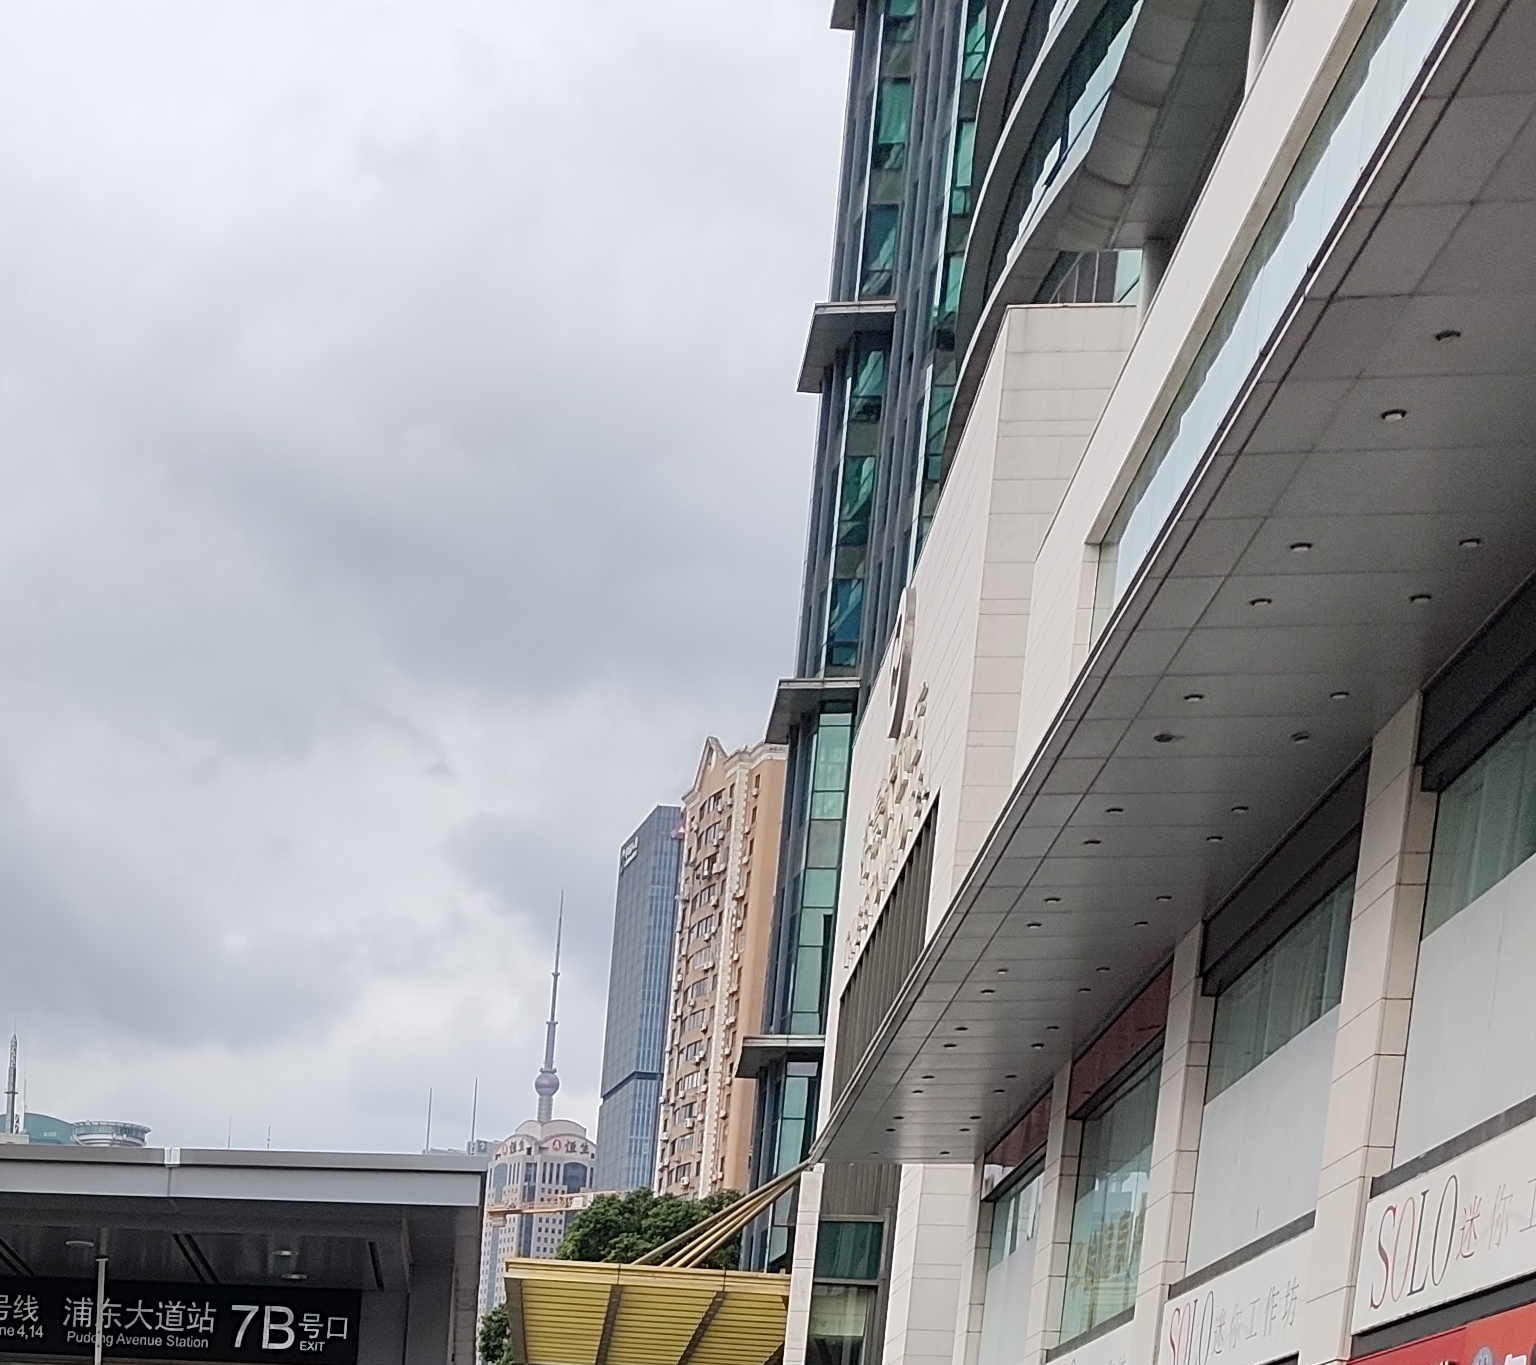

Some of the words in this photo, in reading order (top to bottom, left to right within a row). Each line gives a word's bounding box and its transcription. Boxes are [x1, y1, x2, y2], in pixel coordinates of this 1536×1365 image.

[1369, 1173, 1459, 1310] SOLO
[62, 1296, 218, 1334] 浦东大道站
[230, 1303, 296, 1350] 7B
[298, 1312, 349, 1340] 号口
[16, 1324, 44, 1340] 4,14
[115, 1332, 163, 1347] Avenue
[165, 1334, 209, 1349] Station
[299, 1340, 326, 1352] EXIT
